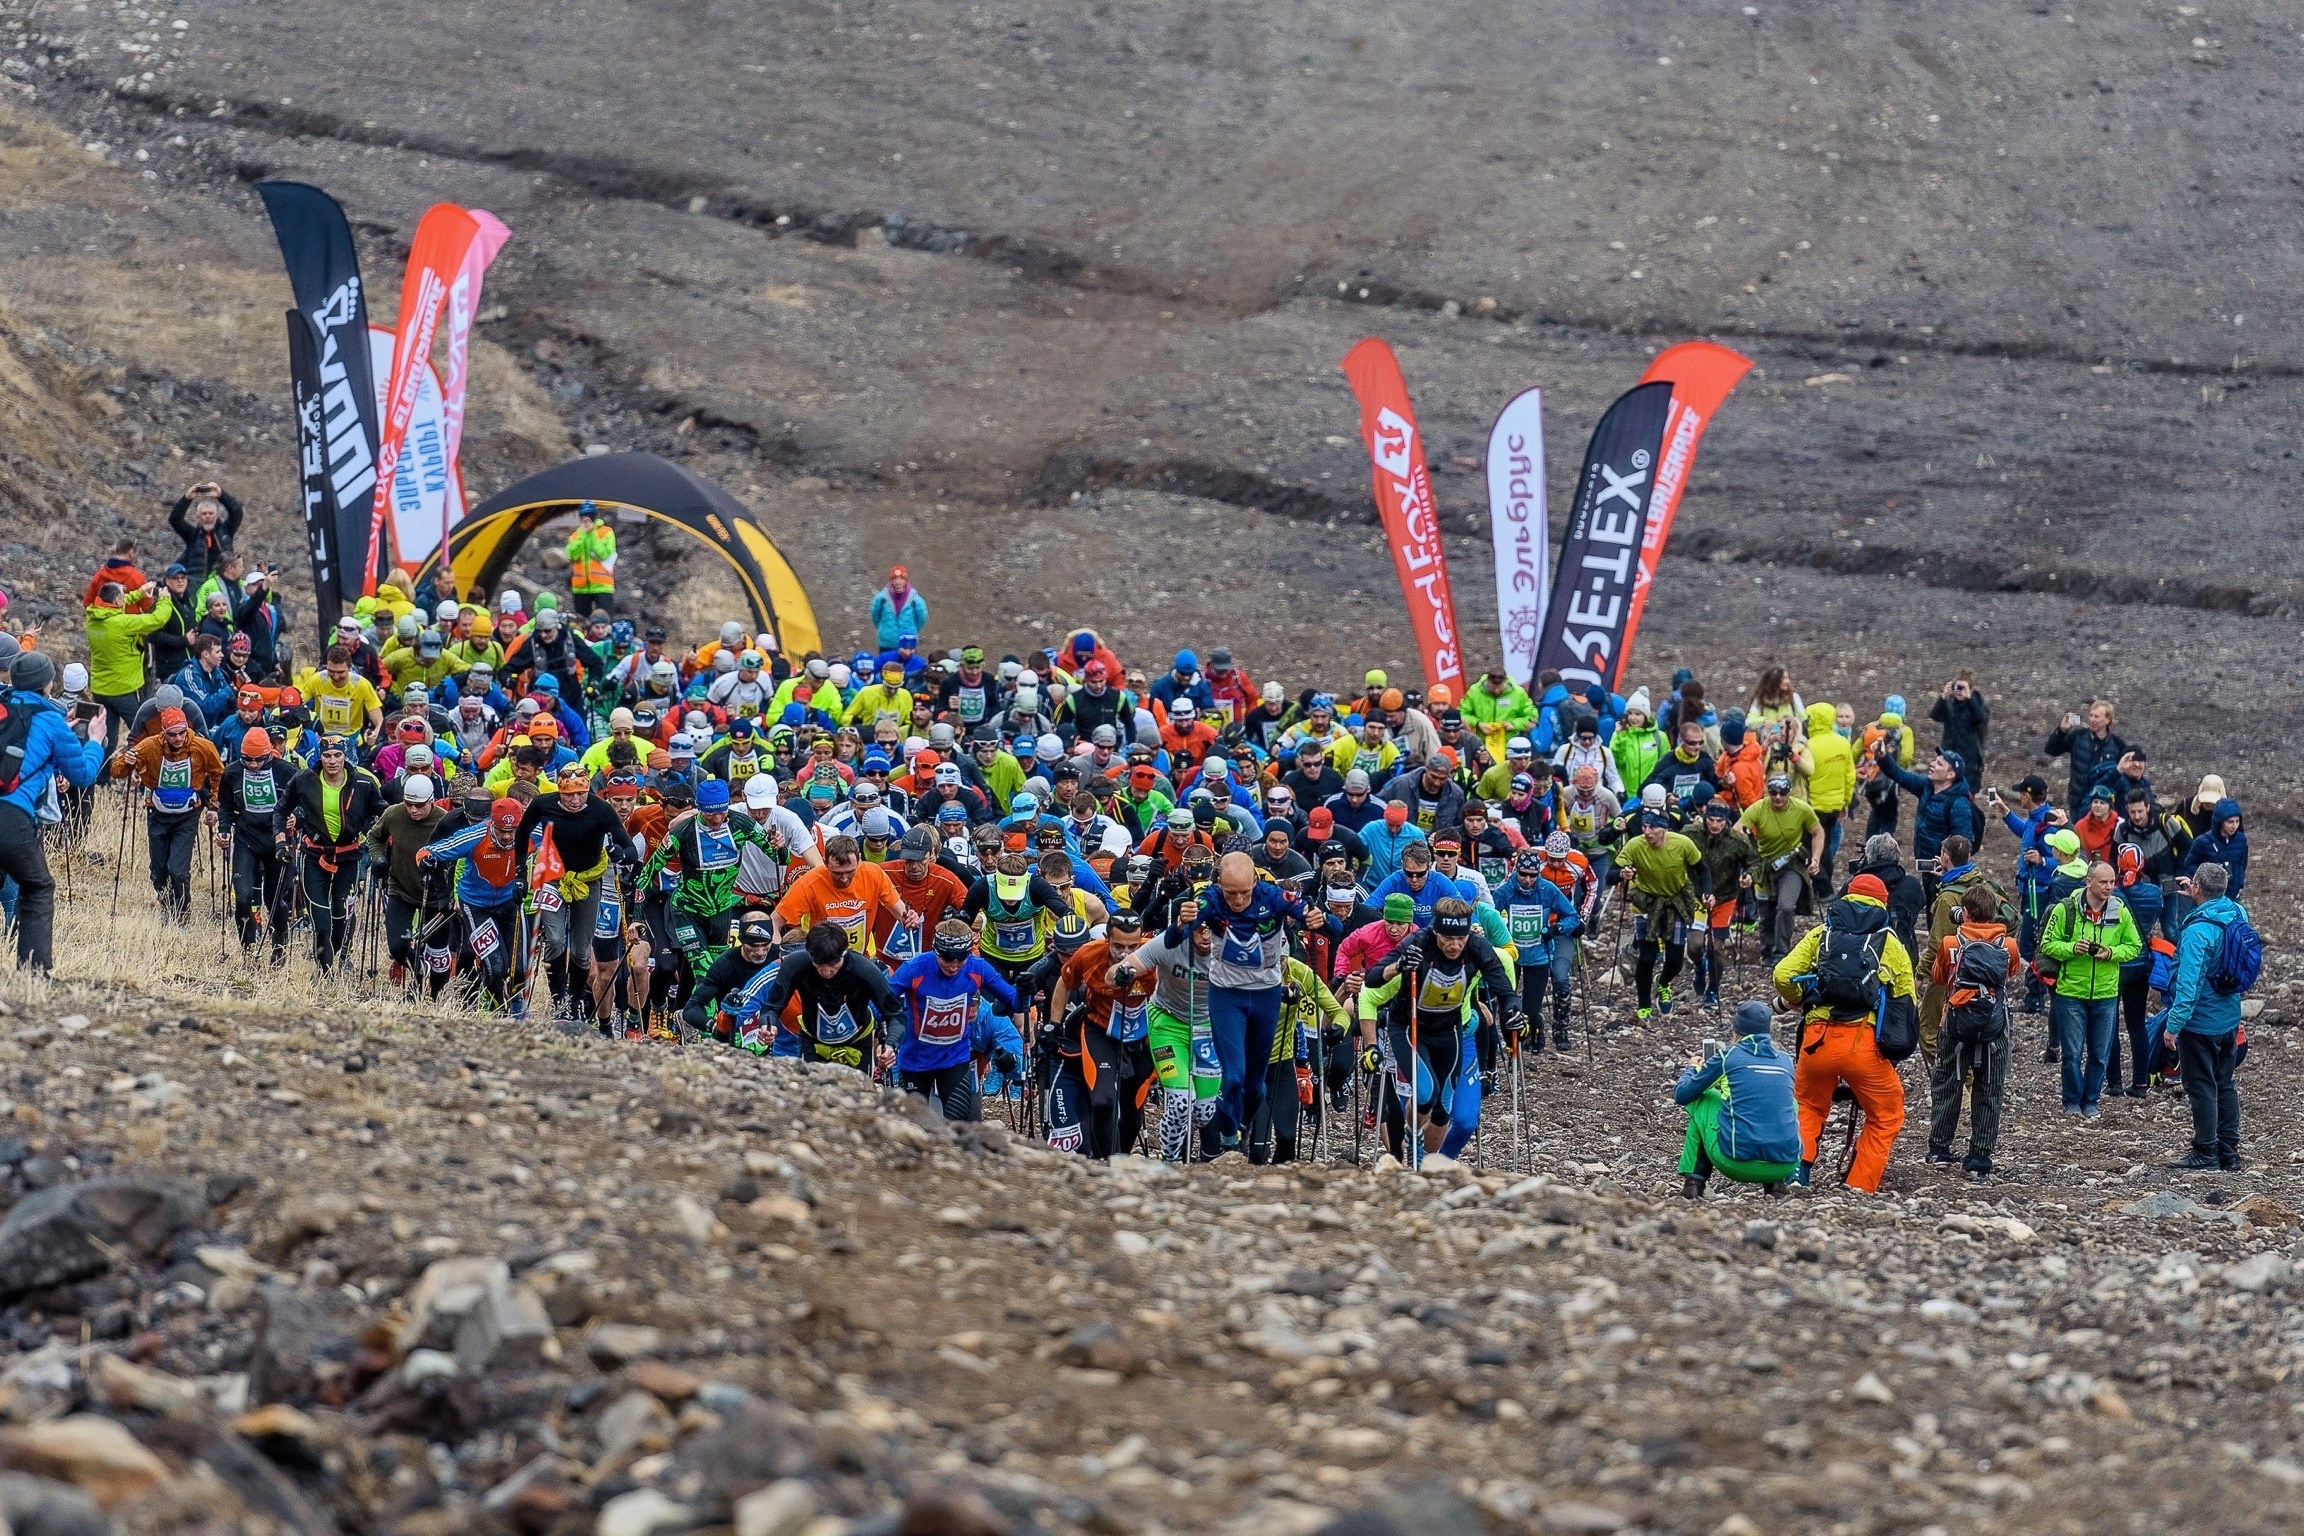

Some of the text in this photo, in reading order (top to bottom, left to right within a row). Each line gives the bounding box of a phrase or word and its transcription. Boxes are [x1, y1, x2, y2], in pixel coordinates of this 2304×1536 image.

[327, 709, 341, 720] 11
[734, 764, 756, 775] 103
[162, 771, 187, 783] 361
[250, 785, 273, 797] 359
[825, 898, 858, 910] saucony
[1514, 920, 1538, 933] 301
[476, 929, 498, 949] 437
[931, 1012, 961, 1028] 440
[1055, 1088, 1068, 1118] CRAFT
